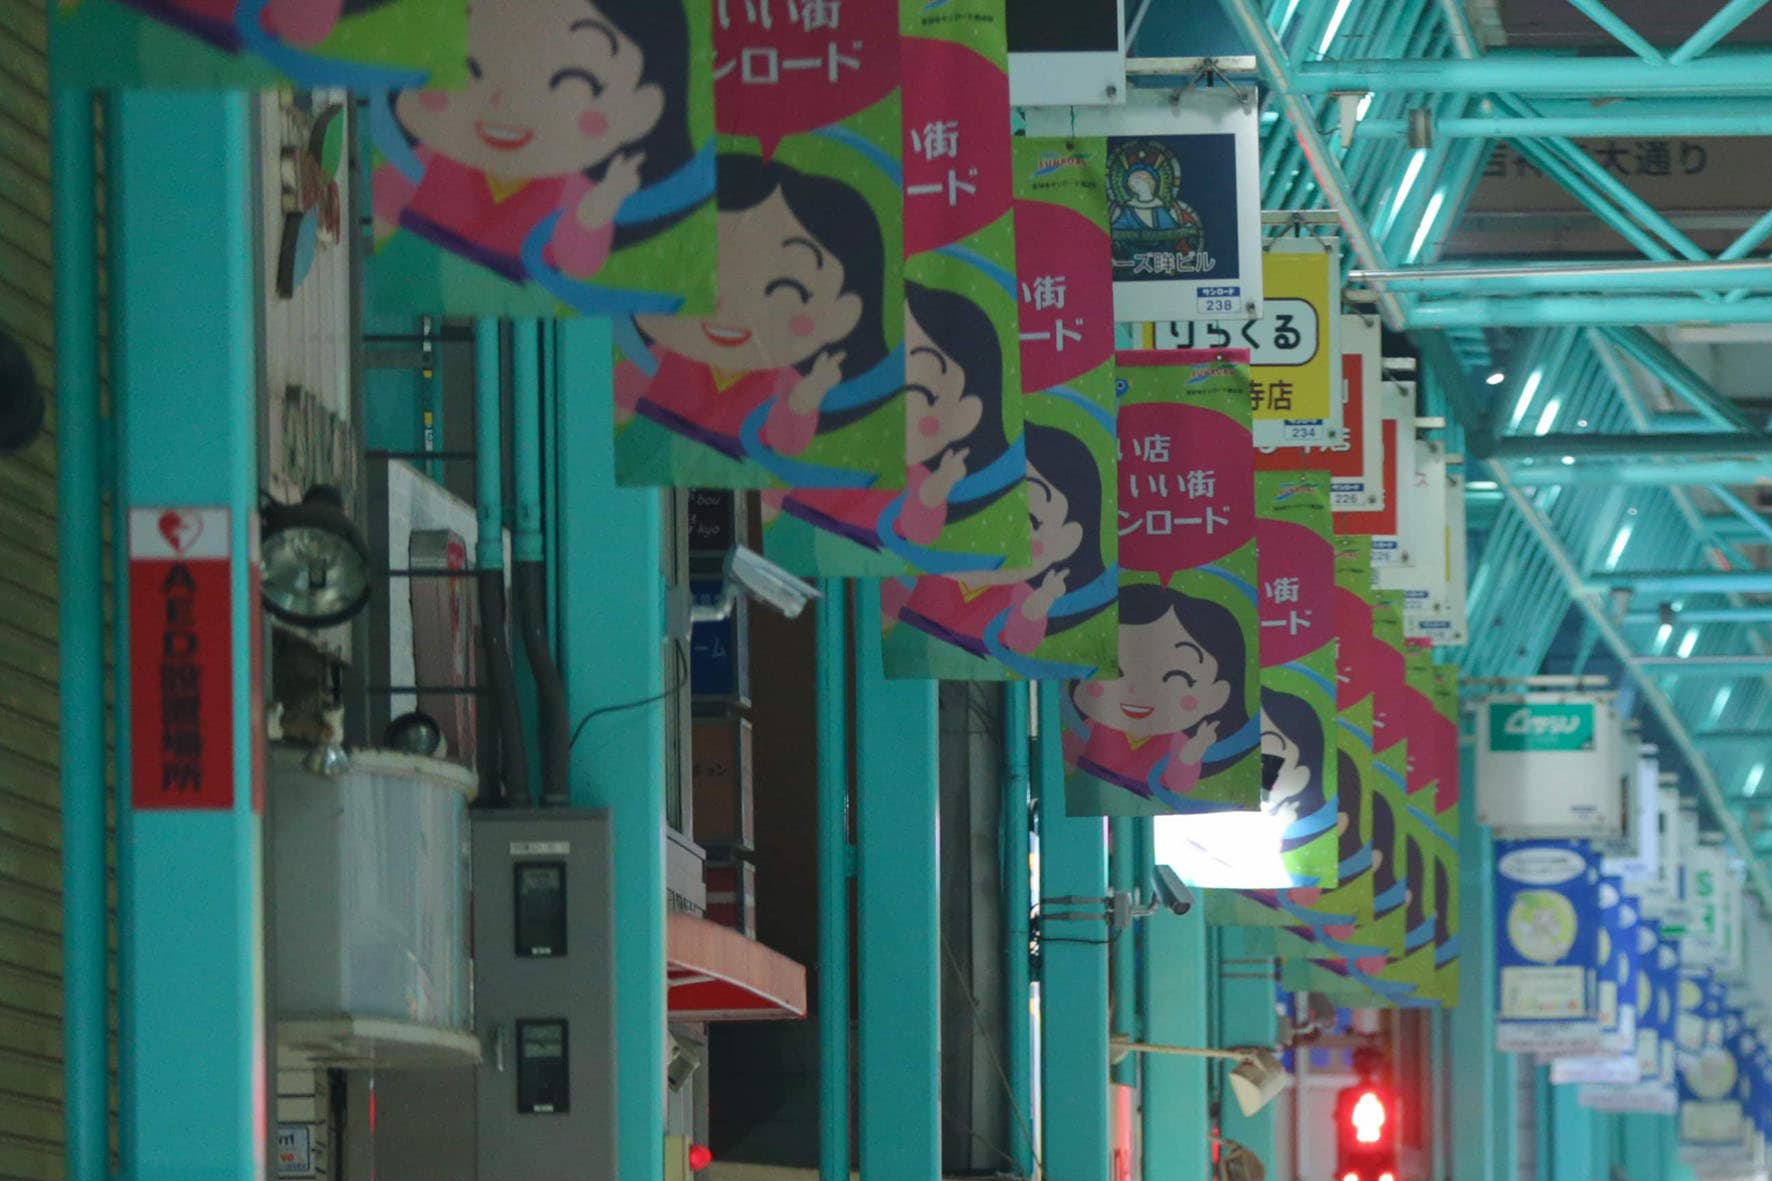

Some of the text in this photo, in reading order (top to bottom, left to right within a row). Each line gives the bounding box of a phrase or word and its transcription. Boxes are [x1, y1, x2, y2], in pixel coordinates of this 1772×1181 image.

[1206, 300, 1232, 311] 238
[1292, 428, 1316, 438] 234
[1130, 470, 1217, 500] いい街
